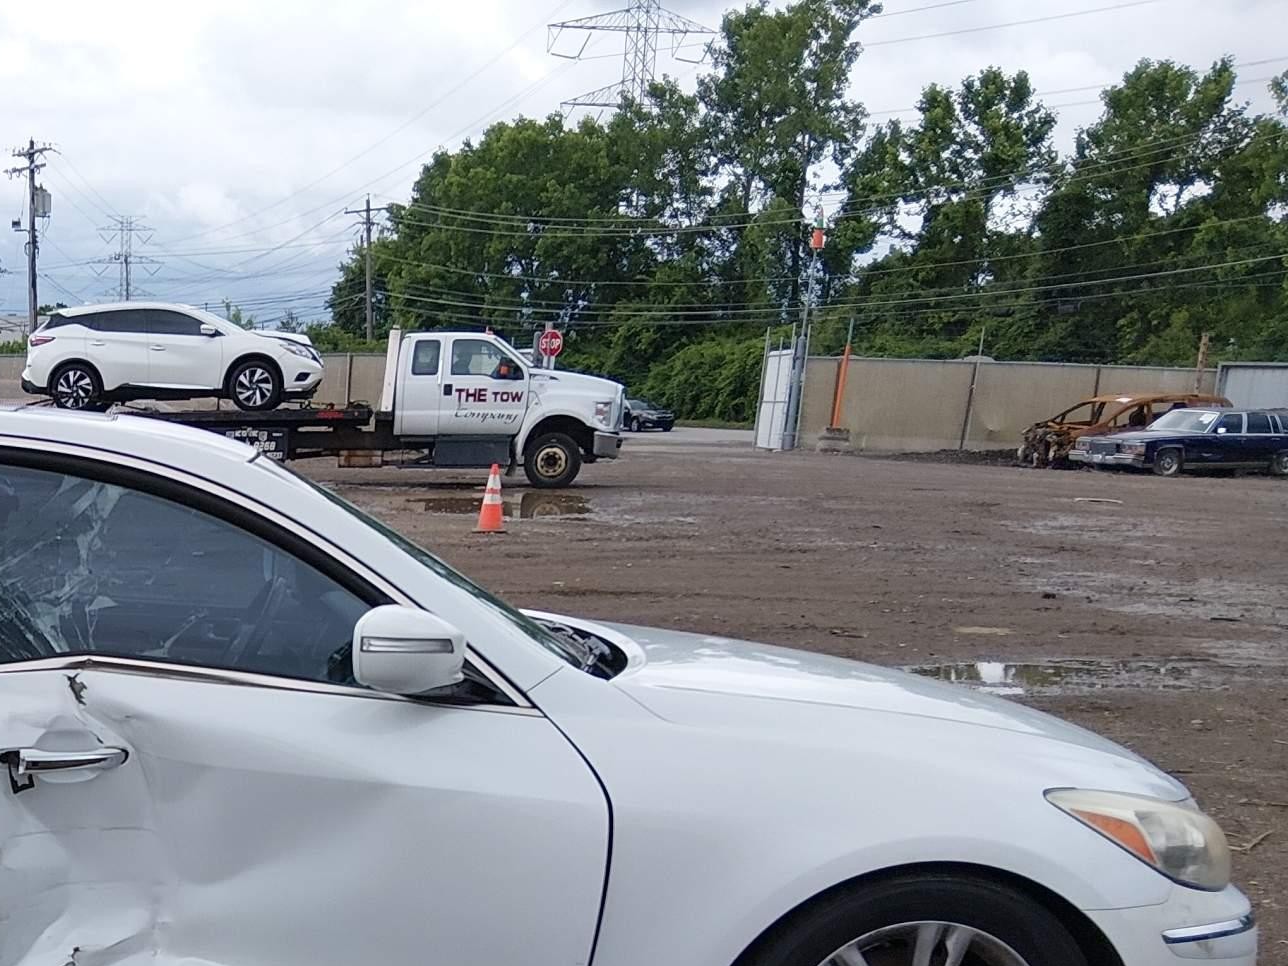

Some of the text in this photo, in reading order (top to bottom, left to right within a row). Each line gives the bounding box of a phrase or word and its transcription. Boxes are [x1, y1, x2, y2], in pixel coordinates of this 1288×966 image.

[541, 338, 561, 349] STOP
[455, 388, 524, 403] THE TOW
[454, 409, 519, 424] Company
